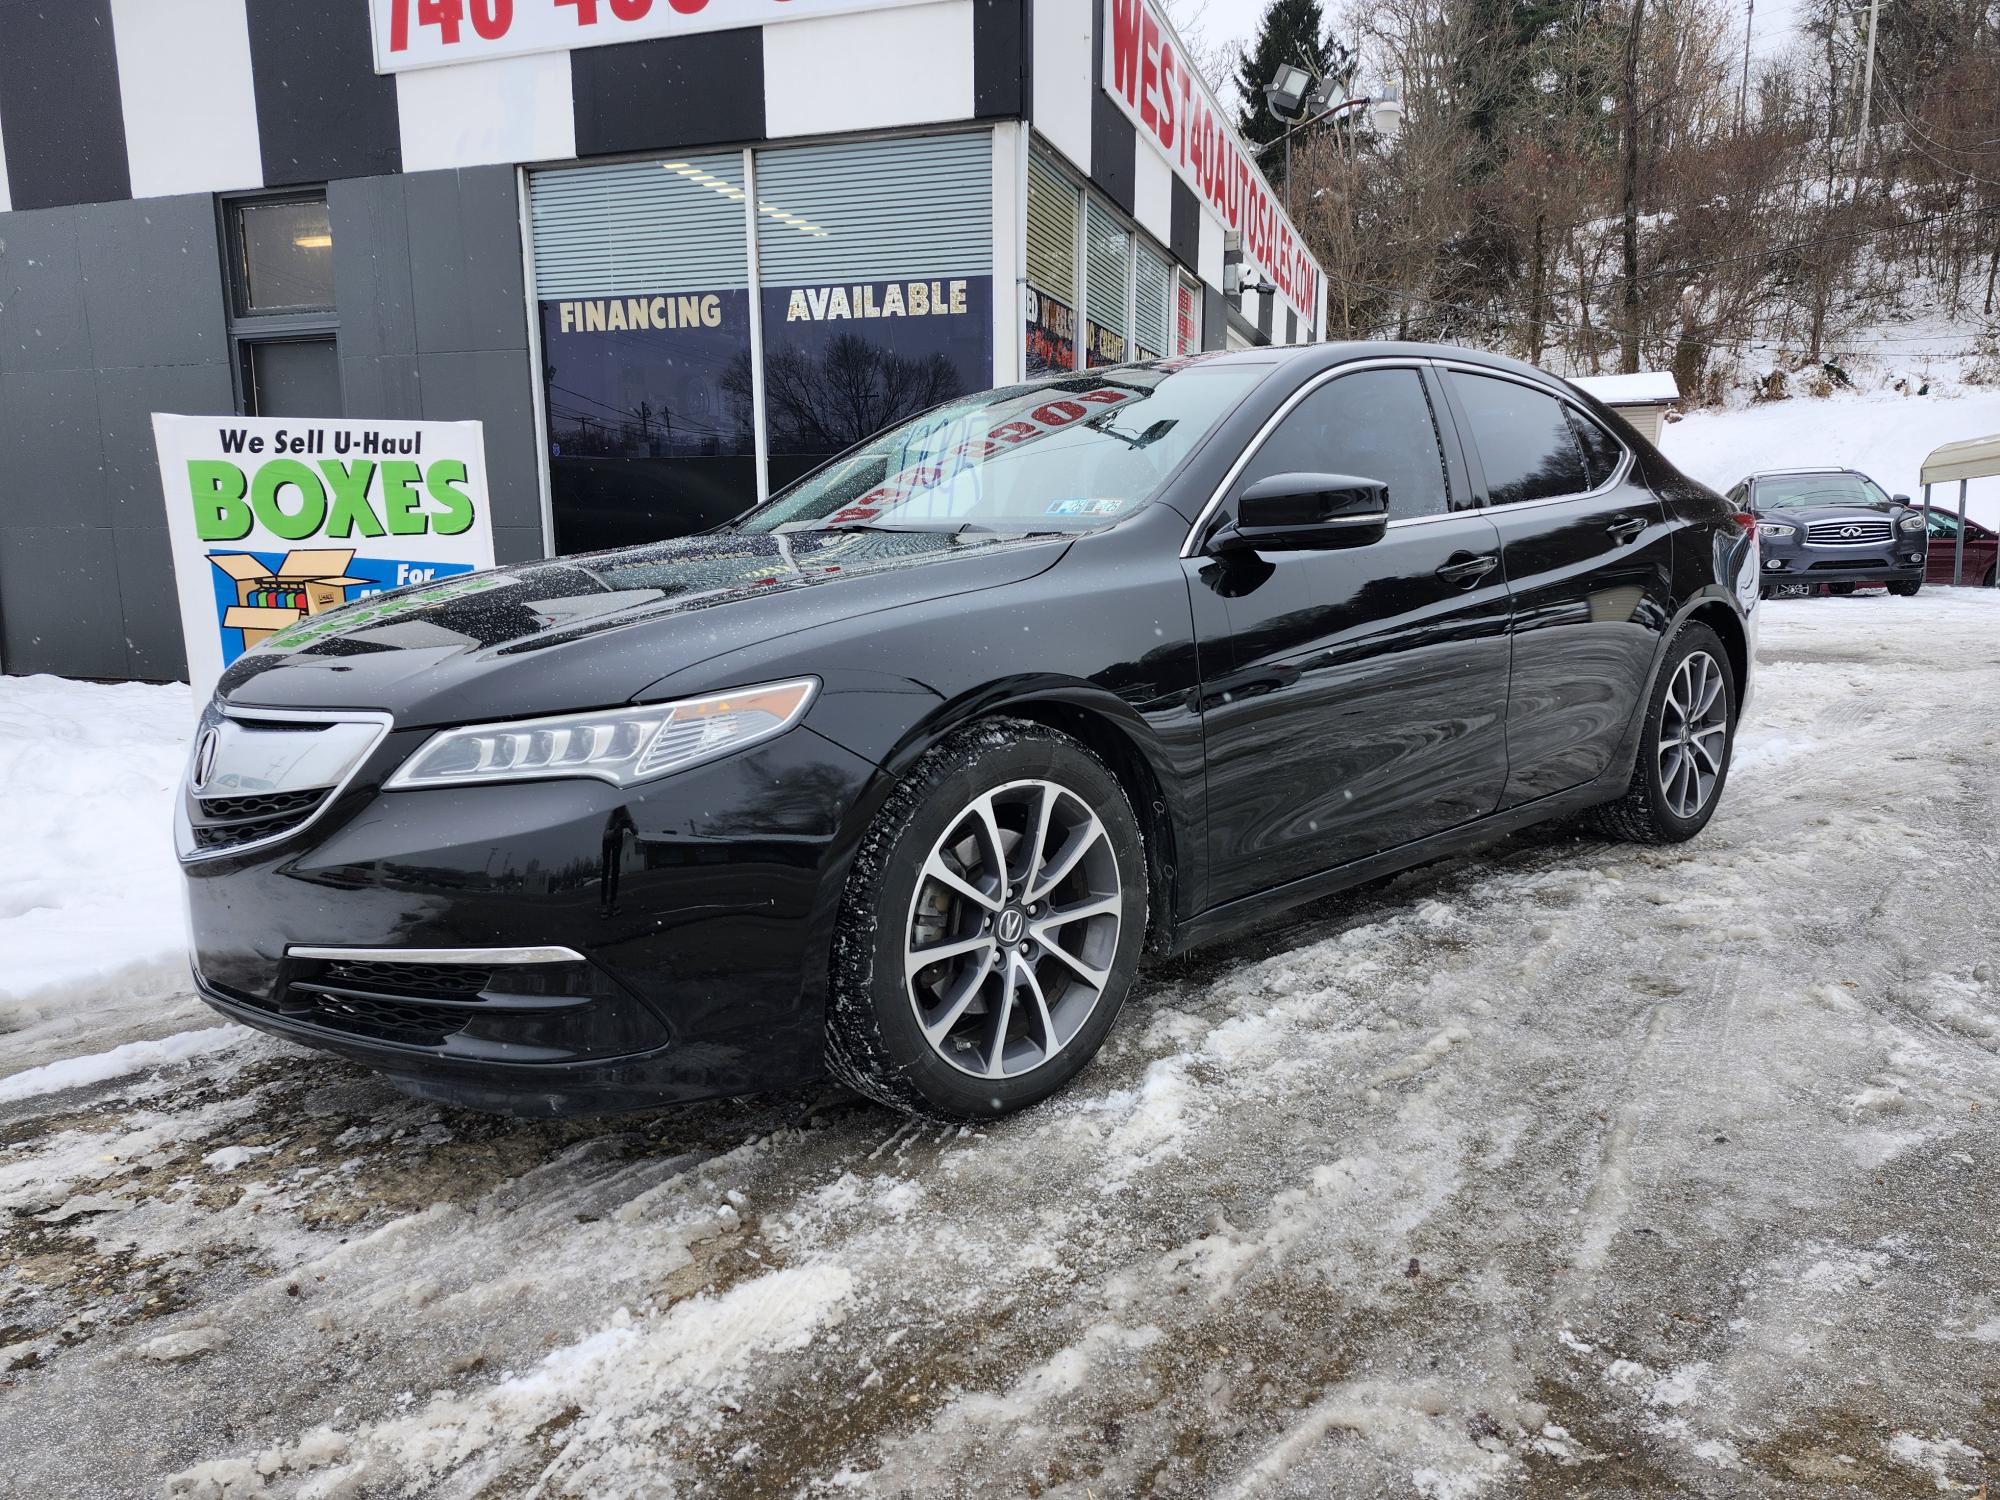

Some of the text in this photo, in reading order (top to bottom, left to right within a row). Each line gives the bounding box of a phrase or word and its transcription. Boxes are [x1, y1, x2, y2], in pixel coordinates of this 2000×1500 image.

[559, 280, 968, 333] FINANCING AVAILABLE
[219, 429, 422, 455] We Sell U-Haul
[186, 458, 475, 541] BOXES
[396, 563, 435, 586] For
